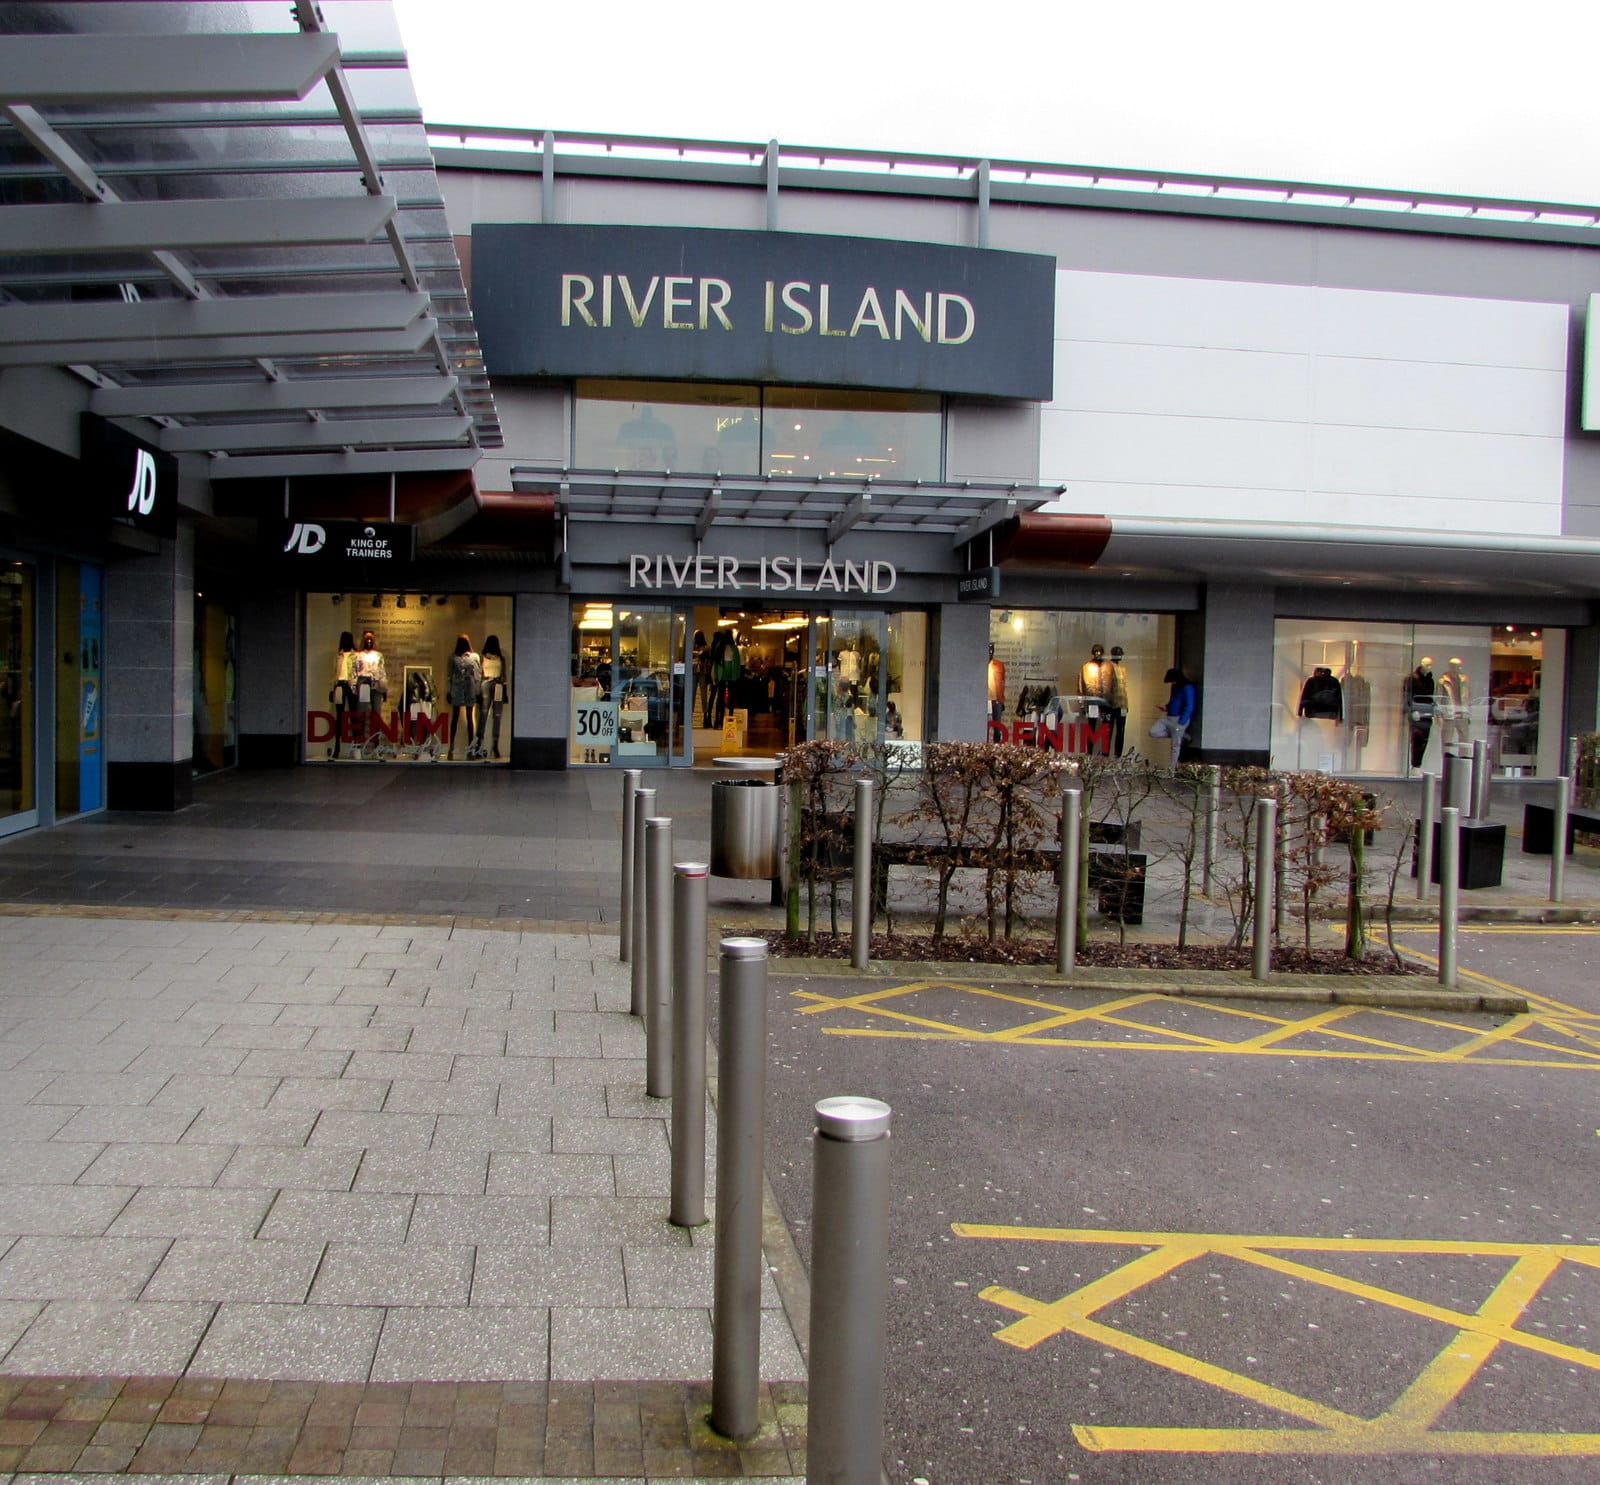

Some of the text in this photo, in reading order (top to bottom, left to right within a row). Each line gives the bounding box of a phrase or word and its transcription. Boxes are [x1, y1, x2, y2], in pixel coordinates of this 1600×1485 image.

[561, 273, 976, 344] RIVER ISLAND
[128, 447, 157, 516] JD
[284, 523, 326, 554] JD
[350, 539, 388, 549] KING OF
[346, 548, 393, 559] TRAINERS
[629, 554, 898, 594] RIVER ISLAND
[972, 577, 988, 591] ISLAND
[390, 618, 425, 626] authenticity
[307, 710, 449, 744] DENIM
[576, 709, 614, 736] 30%
[601, 728, 614, 736] OFF
[987, 720, 1112, 753] DENIM
